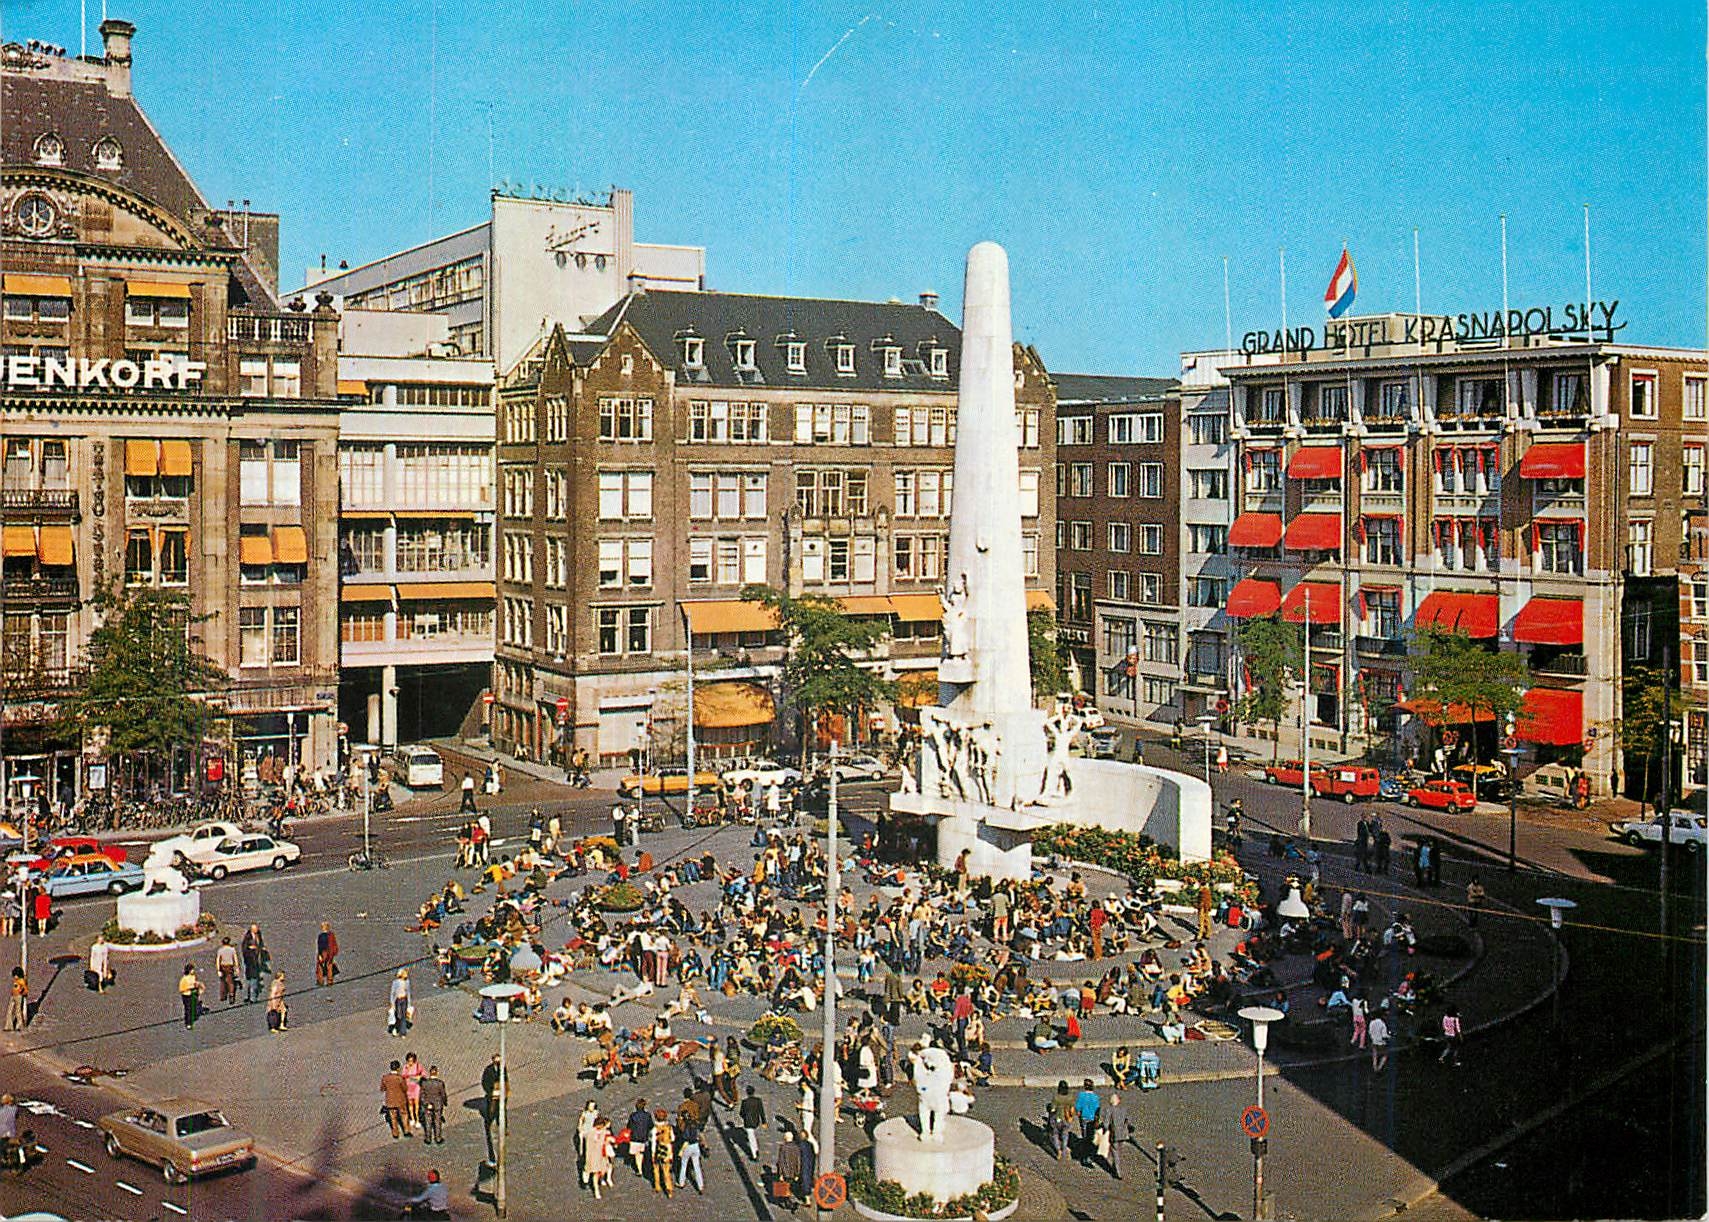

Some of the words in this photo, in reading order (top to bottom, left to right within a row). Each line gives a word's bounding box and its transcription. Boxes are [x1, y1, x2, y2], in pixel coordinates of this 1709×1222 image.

[1242, 327, 1315, 354] GRAND
[1323, 320, 1393, 350] HOTEL
[1404, 300, 1627, 345] KRASNAPOLSKY
